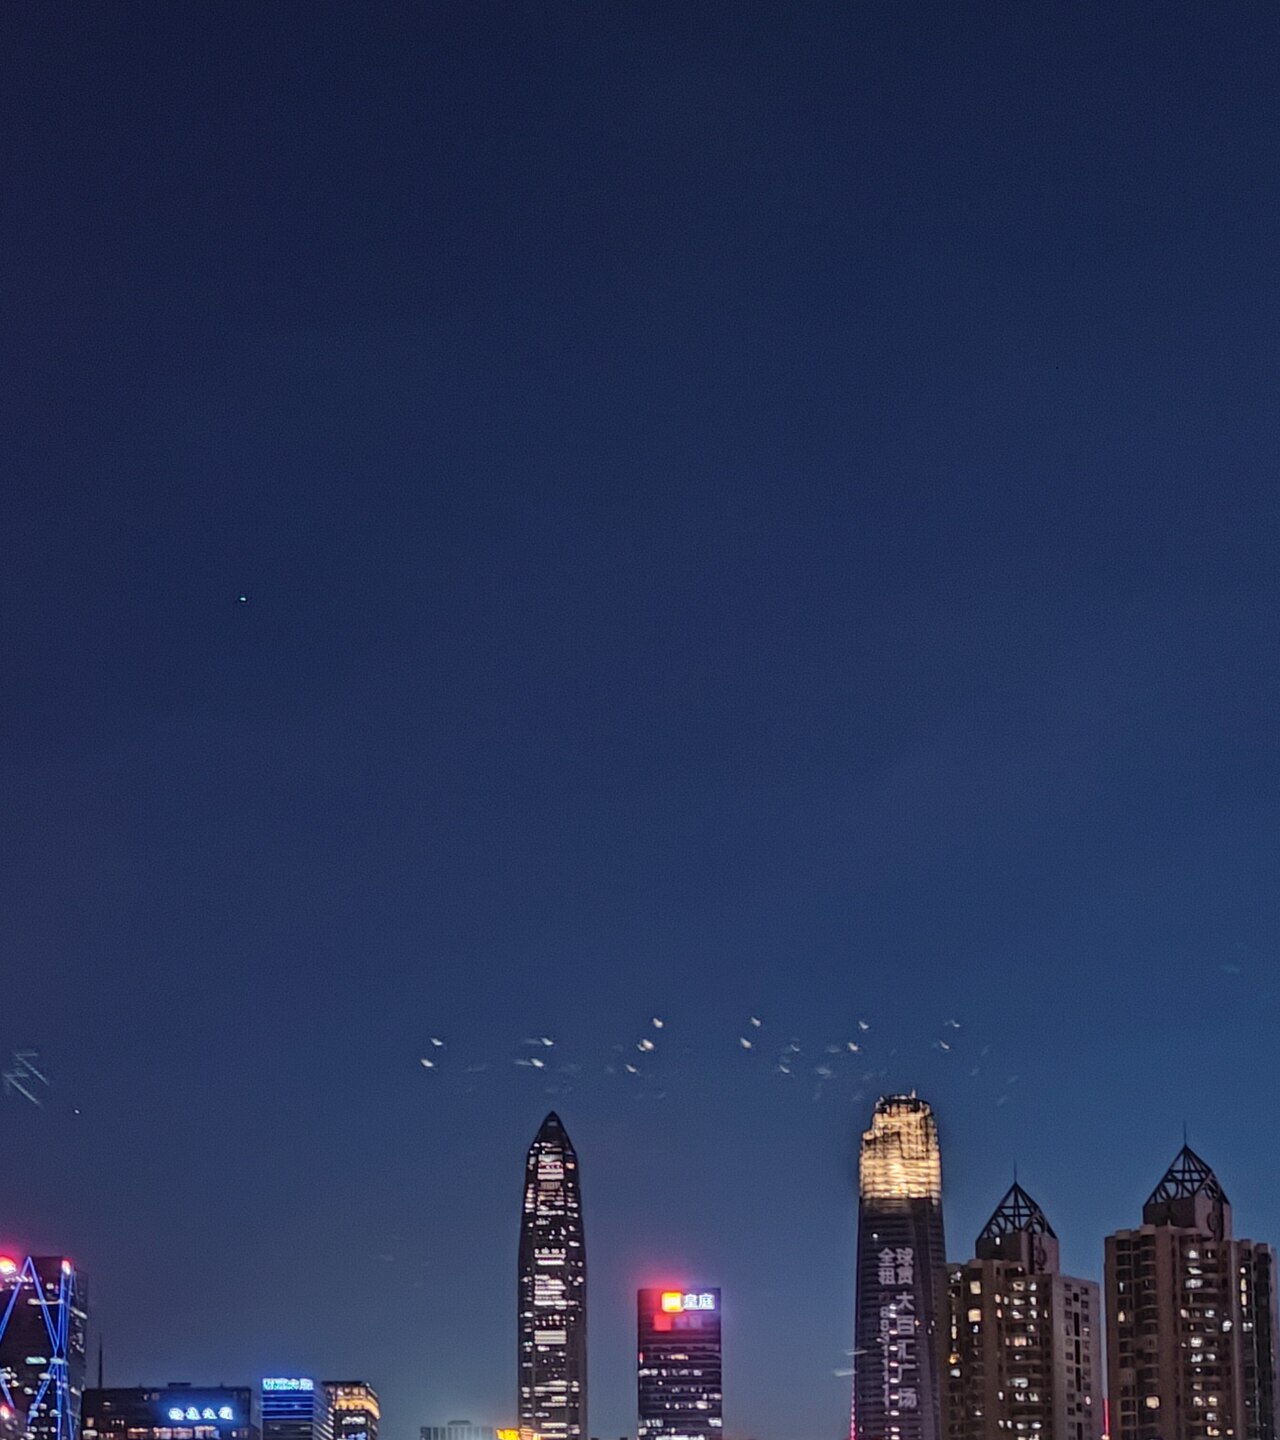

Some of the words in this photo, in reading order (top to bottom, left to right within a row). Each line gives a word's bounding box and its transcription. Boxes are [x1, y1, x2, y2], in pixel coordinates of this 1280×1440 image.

[683, 1293, 715, 1310] 皇庭
[895, 1291, 918, 1408] 大百汇广场
